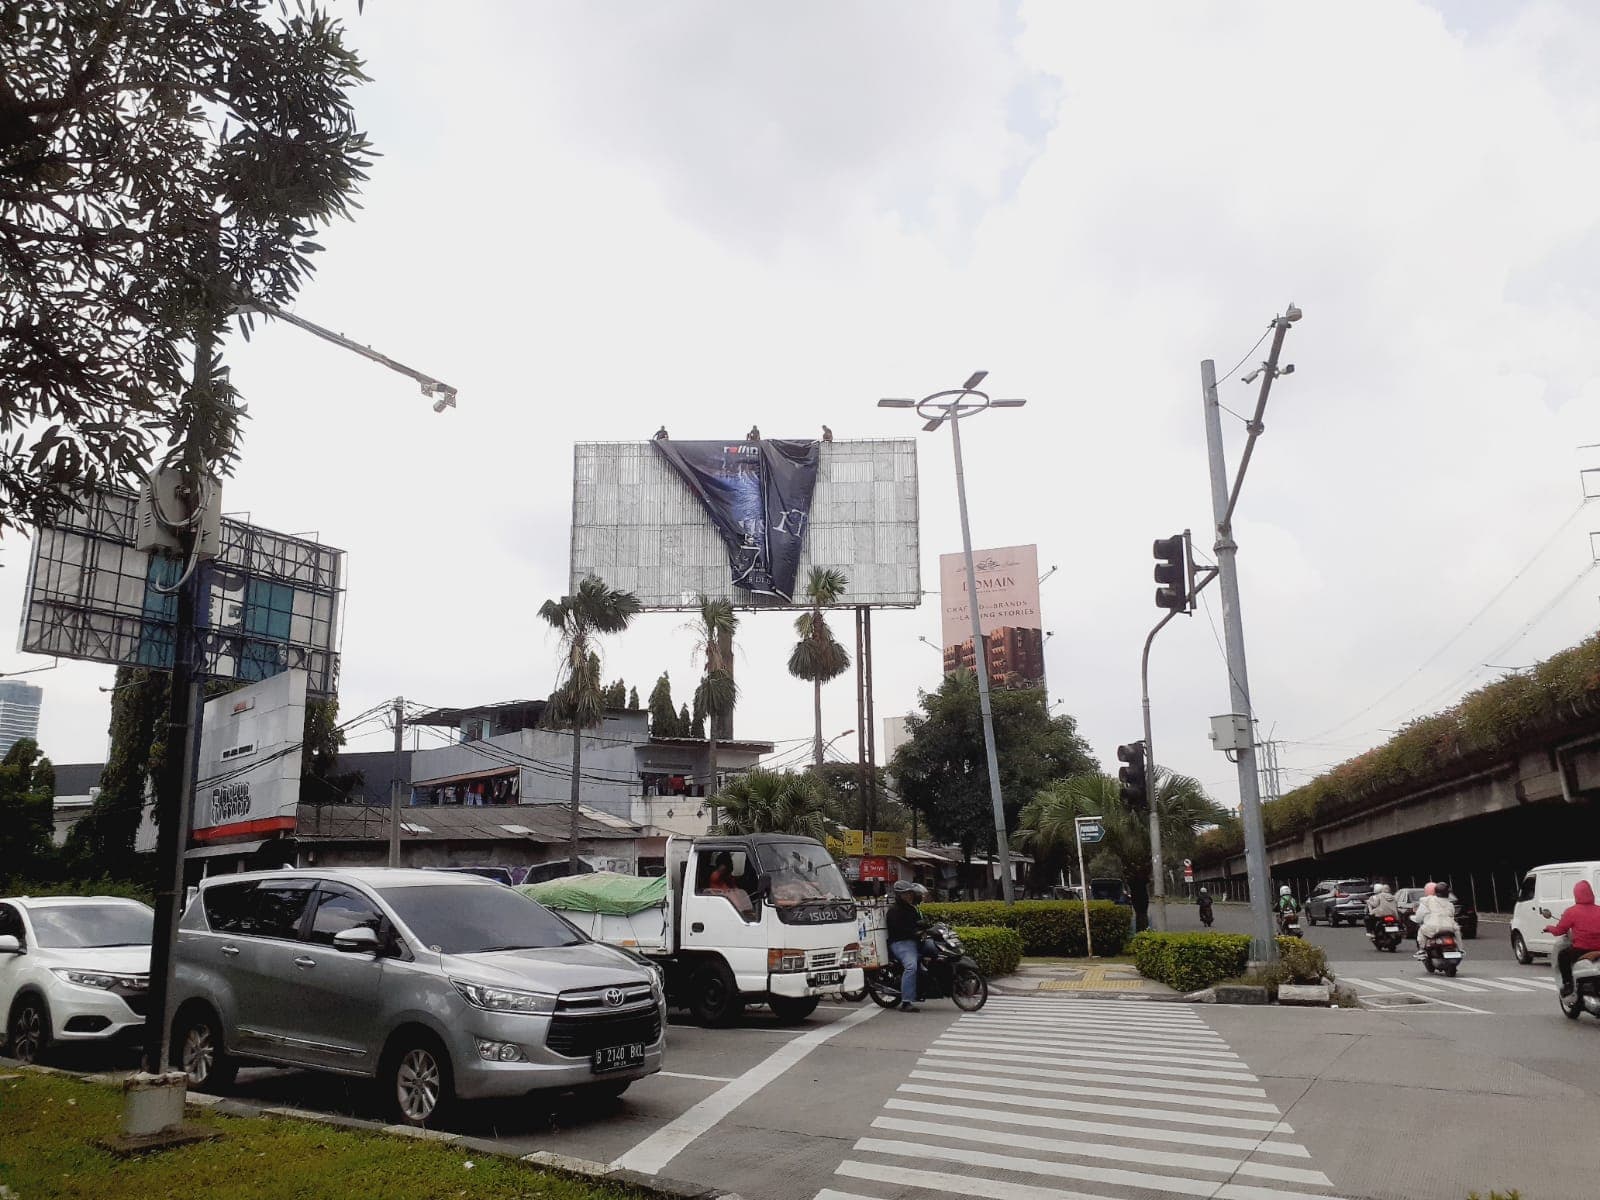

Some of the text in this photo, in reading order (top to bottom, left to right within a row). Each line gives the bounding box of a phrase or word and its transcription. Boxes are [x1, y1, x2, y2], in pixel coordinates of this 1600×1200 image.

[959, 608, 1035, 621] LAING STORIES
[596, 1051, 602, 1065] B
[607, 1047, 625, 1062] 2140
